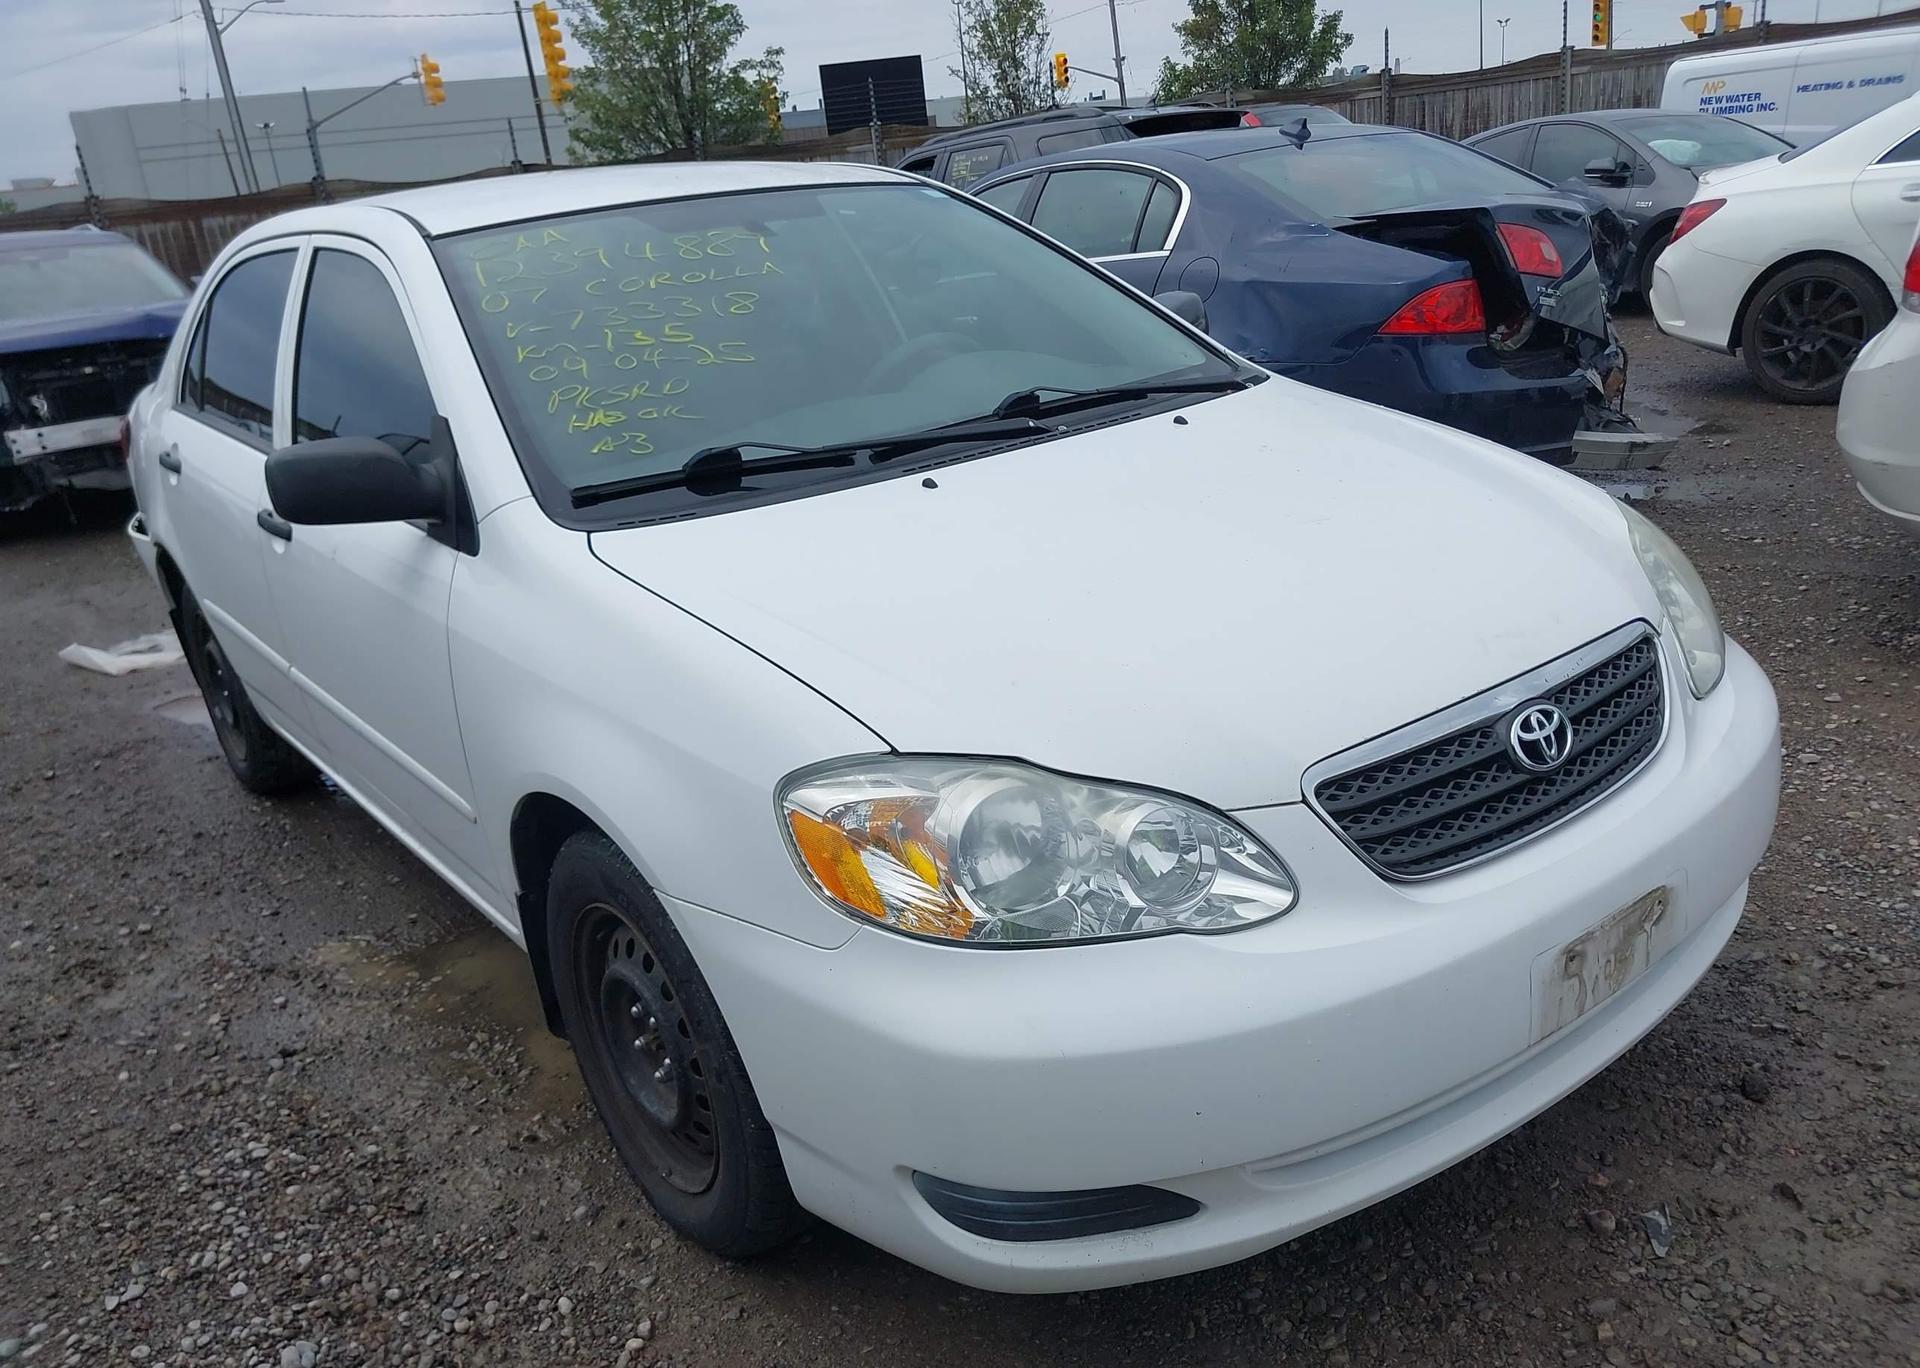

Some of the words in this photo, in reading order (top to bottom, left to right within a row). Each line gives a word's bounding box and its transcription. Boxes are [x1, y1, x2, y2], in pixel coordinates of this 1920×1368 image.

[1796, 80, 1843, 93] HEATING
[1846, 80, 1855, 89] &
[1859, 74, 1905, 88] DRAINS
[1700, 96, 1724, 106] NEW
[1725, 92, 1762, 103] WATER
[1756, 102, 1778, 112] INC.
[585, 261, 785, 296] COROLLA
